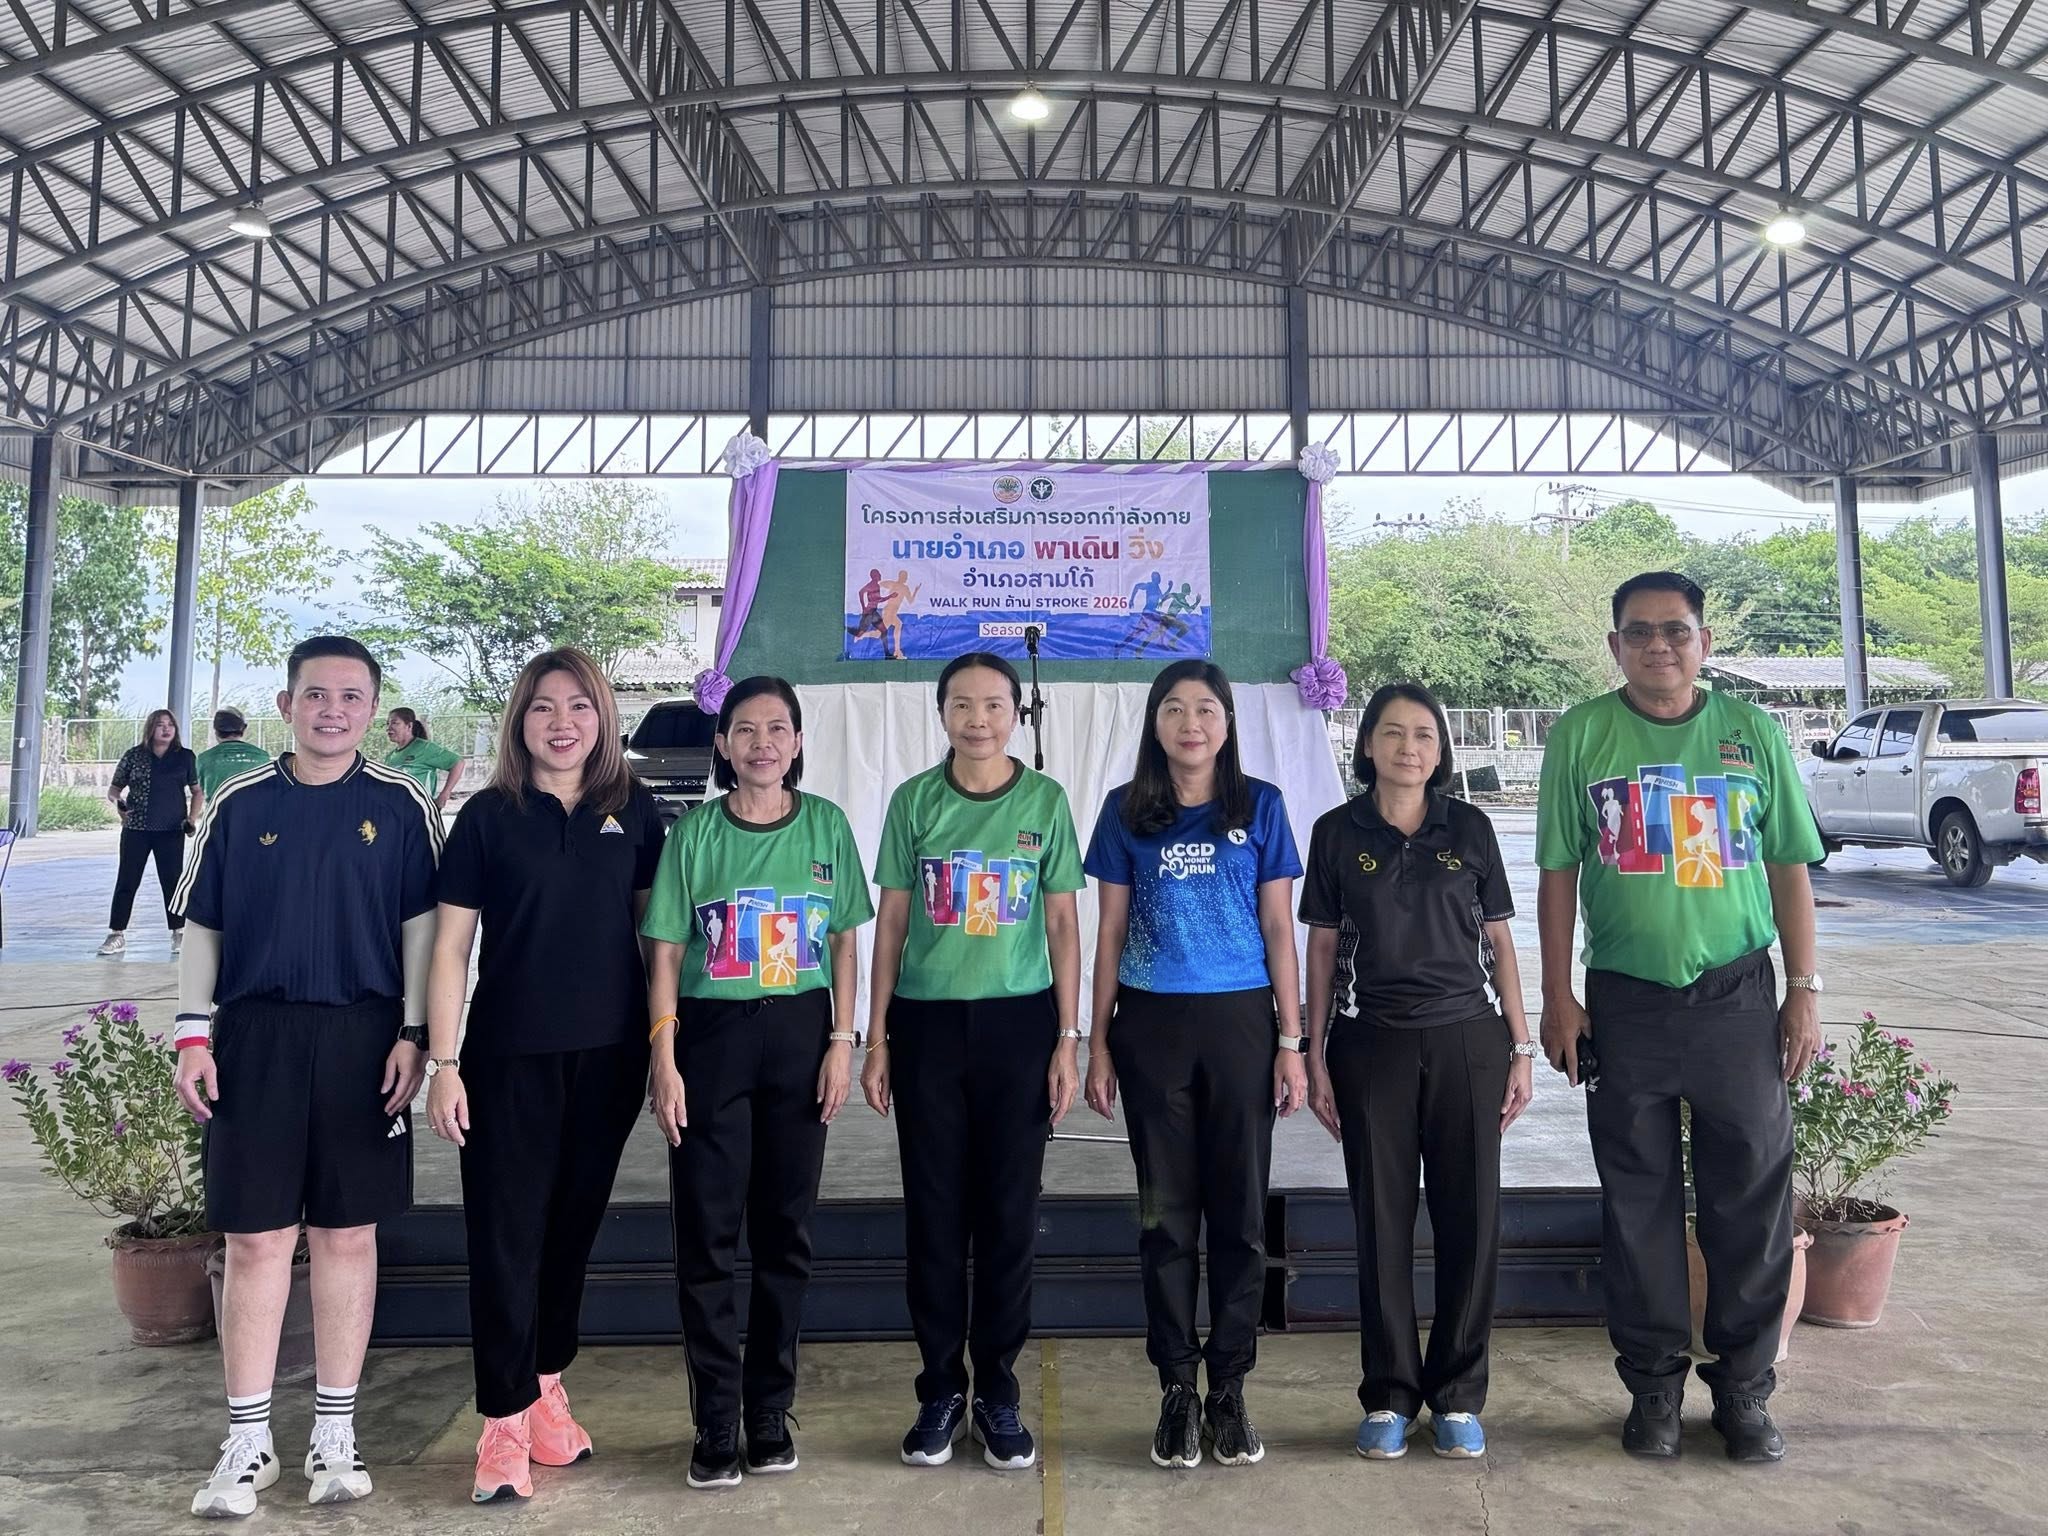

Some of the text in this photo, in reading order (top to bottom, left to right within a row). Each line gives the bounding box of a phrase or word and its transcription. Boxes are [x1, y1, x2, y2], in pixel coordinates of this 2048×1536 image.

[861, 504, 1191, 525] โครงการส่งเสริมการออกกำลังกาย
[893, 527, 1165, 560] นายอำเภอ พาเดิน วิ่ง
[963, 566, 1094, 588] อำเภอสามโก้
[930, 597, 967, 608] WALK
[972, 597, 1000, 608] RUN
[1036, 597, 1088, 608] STROKE
[1093, 596, 1128, 609] 2026
[982, 623, 1029, 636] Seaso
[1720, 752, 1742, 761] BIKE
[1172, 843, 1216, 857] CGD
[1189, 864, 1216, 875] RUN
